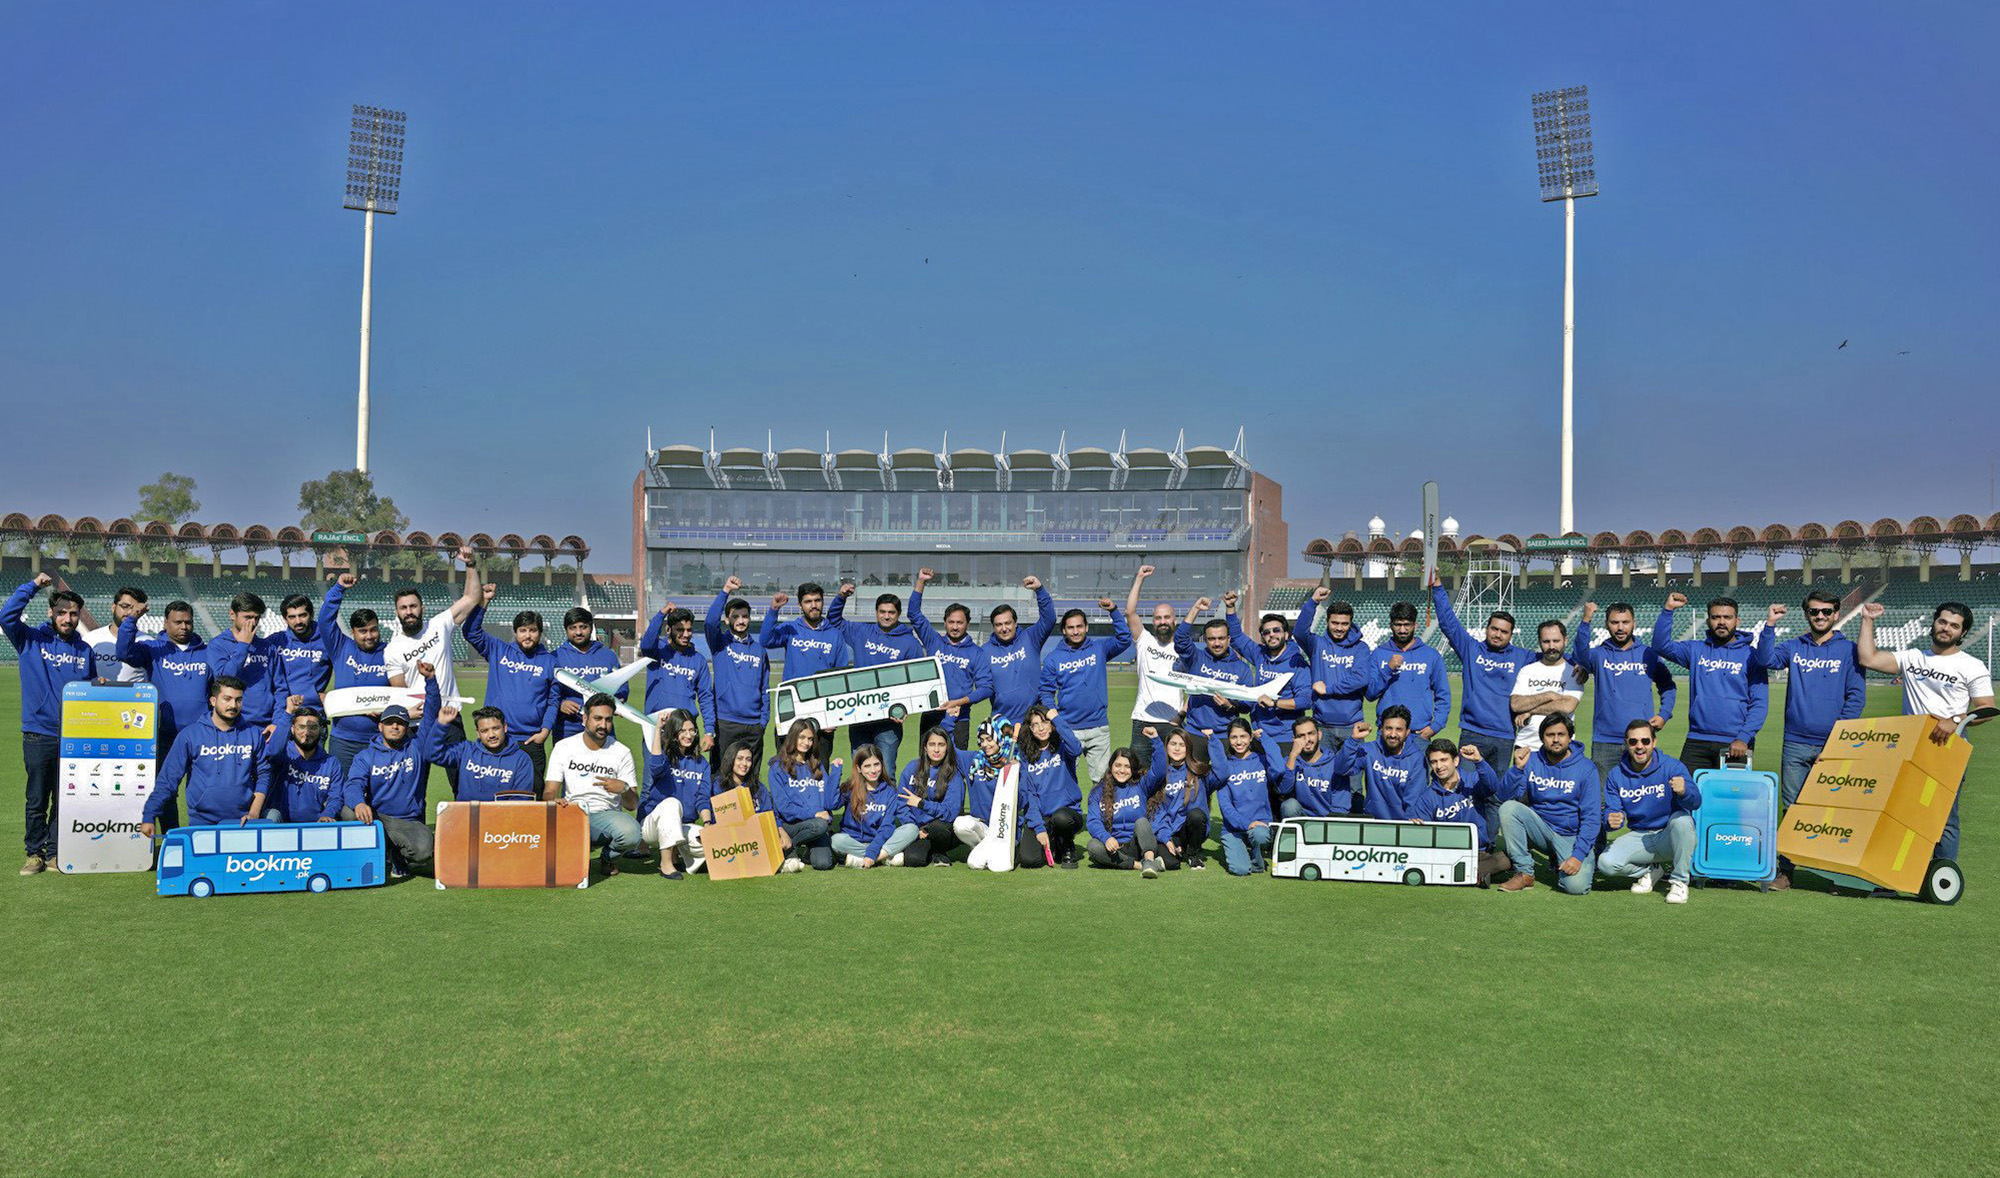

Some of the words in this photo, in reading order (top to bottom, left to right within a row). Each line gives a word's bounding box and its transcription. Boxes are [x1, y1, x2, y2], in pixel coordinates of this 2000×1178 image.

[342, 534, 361, 542] ENCL
[278, 646, 322, 658] bookme
[791, 638, 832, 650] bookme
[41, 648, 85, 664] bookme
[1698, 655, 1743, 671] bookme
[1793, 652, 1841, 668] bookme
[162, 659, 207, 671] bookme
[500, 656, 544, 674] bookme
[661, 659, 696, 676] bookme
[1201, 664, 1238, 681] bookme
[1603, 659, 1647, 672] bookme
[1906, 663, 1958, 684] bookme
[356, 695, 390, 703] bookme
[826, 691, 890, 711] bookme
[1839, 729, 1900, 743] bookme
[200, 743, 252, 756] bookme
[371, 757, 413, 776] bookme
[465, 759, 513, 779] bookme
[569, 760, 614, 775] bookme
[1229, 769, 1266, 782] ookme
[1296, 772, 1329, 788] bkme
[1528, 771, 1575, 789] bookme
[1816, 772, 1877, 788] bookme
[1620, 783, 1665, 798] bookme
[72, 819, 142, 833] bookme
[997, 803, 1008, 838] bookme
[1793, 819, 1853, 838] bookme
[483, 831, 541, 843] bookme
[1715, 833, 1753, 843] bookme
[712, 841, 759, 859] bookme
[1332, 846, 1409, 863] bookme
[225, 854, 312, 873] bookme
[295, 871, 310, 879] .pk
